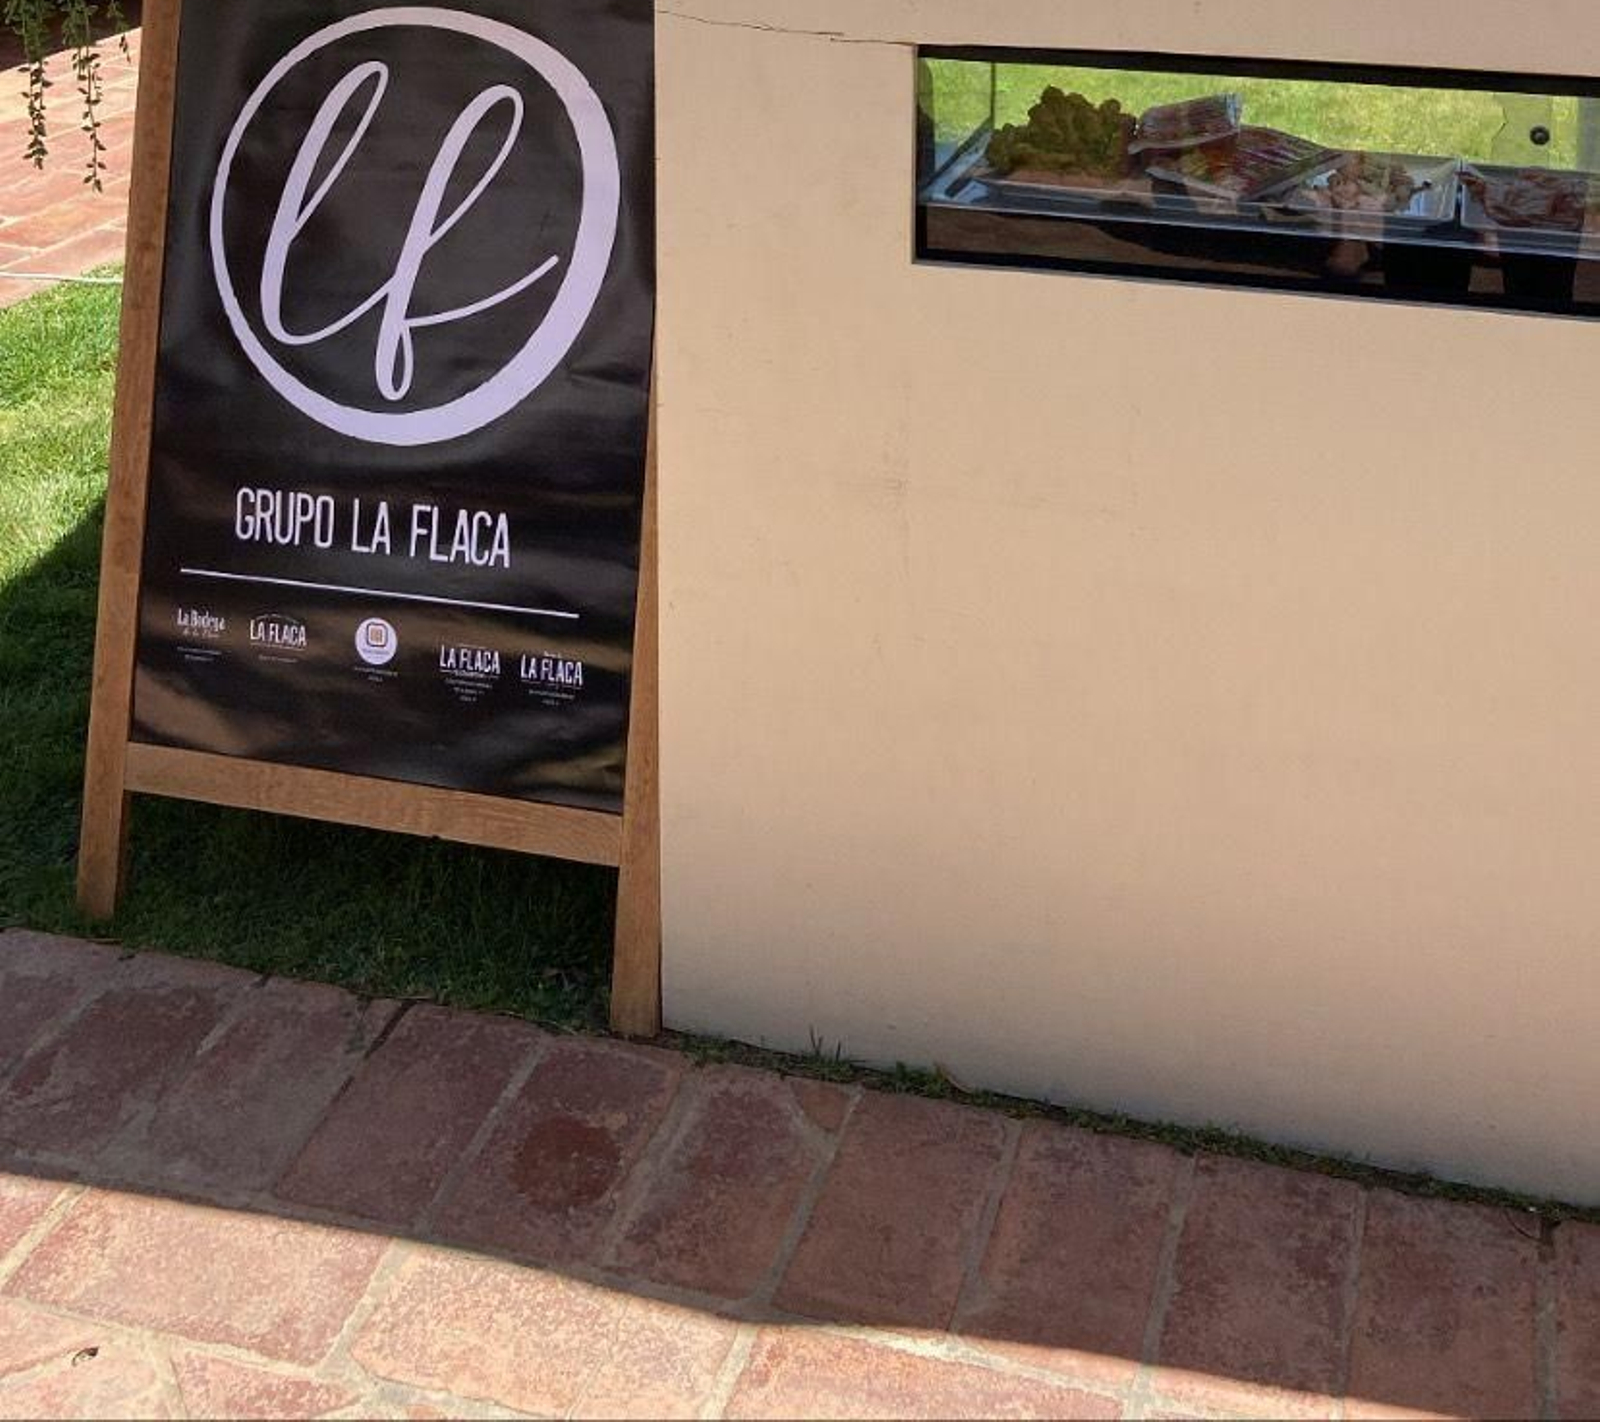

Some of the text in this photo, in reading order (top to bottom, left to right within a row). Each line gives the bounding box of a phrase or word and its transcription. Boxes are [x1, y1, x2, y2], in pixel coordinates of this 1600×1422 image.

[235, 486, 511, 568] GRUPO LA FLACA
[250, 619, 266, 642] LA
[268, 622, 308, 647] FLACA
[439, 644, 501, 675] LA FLACA
[520, 653, 584, 686] LA FLACA
